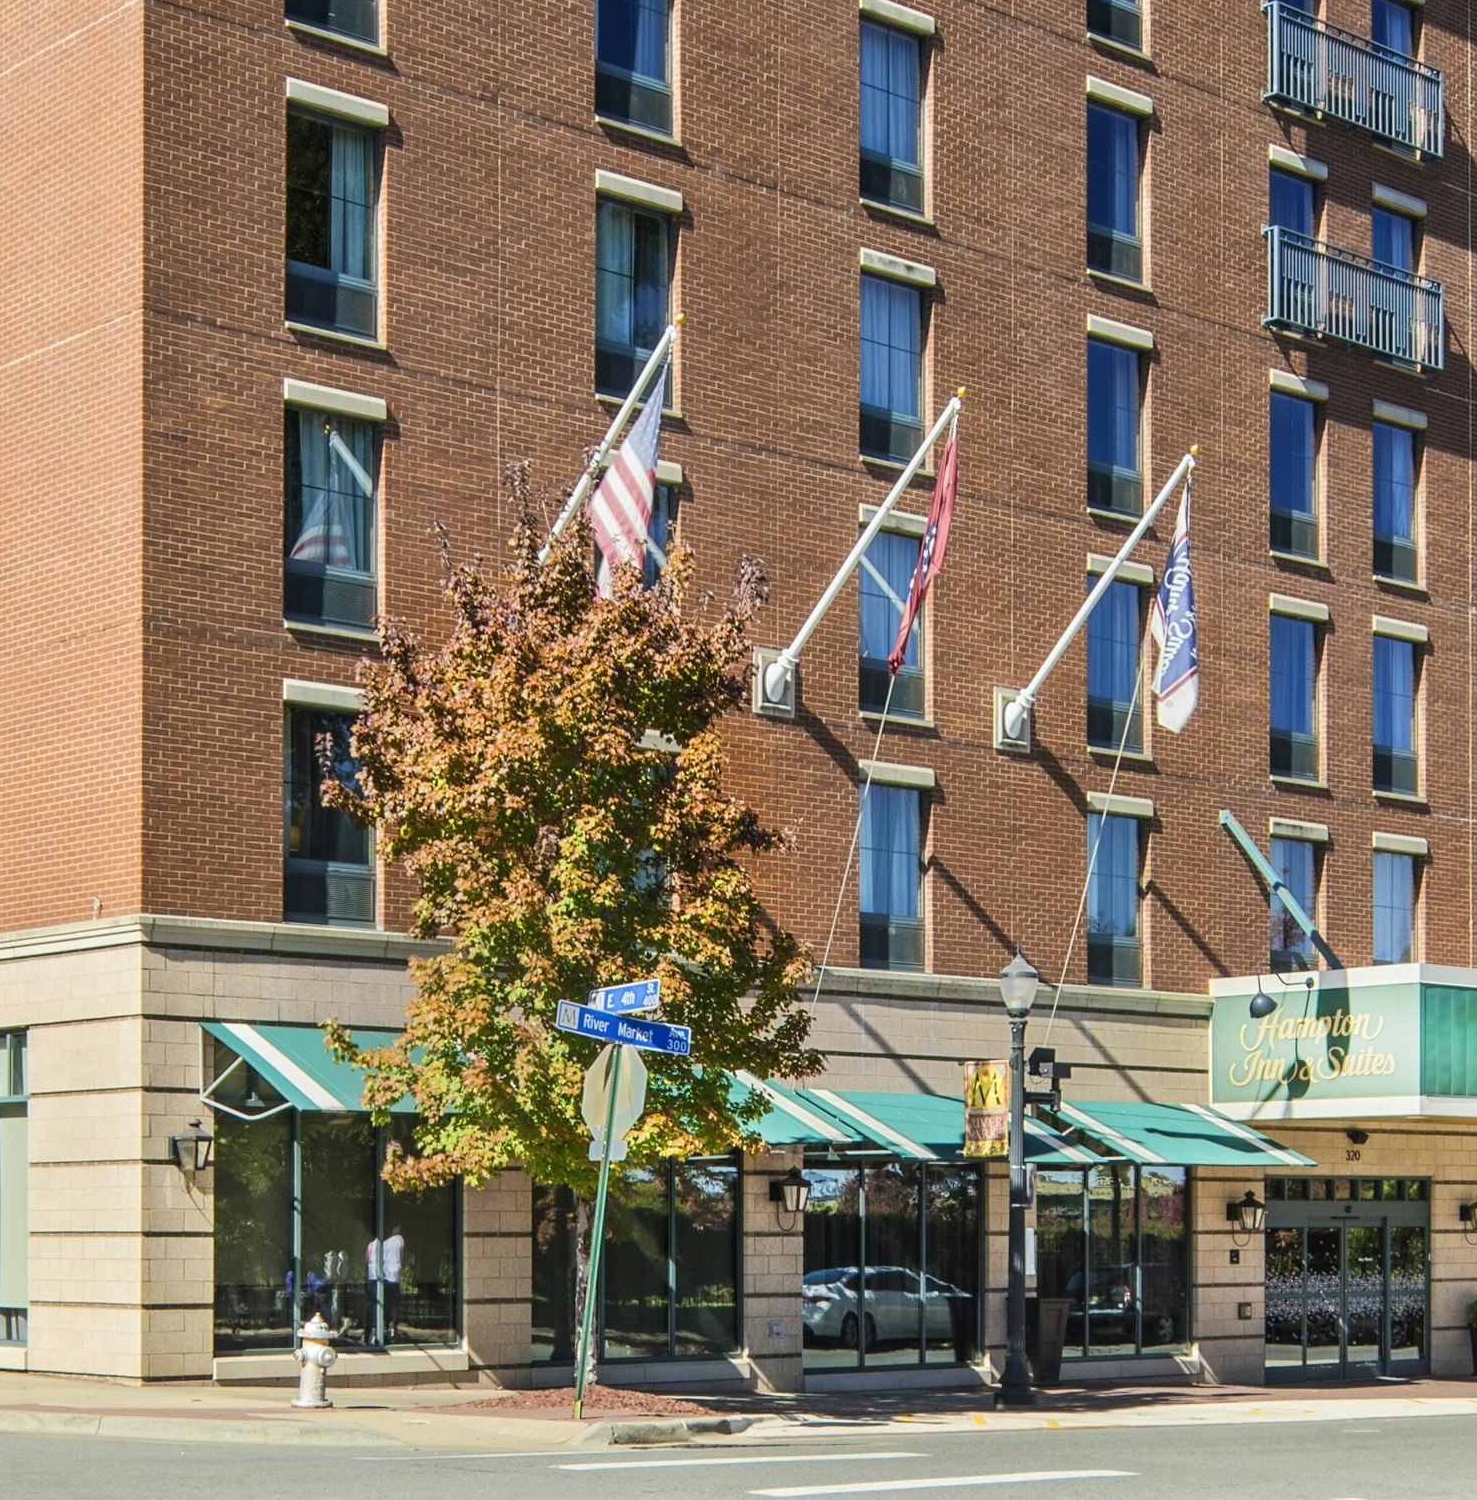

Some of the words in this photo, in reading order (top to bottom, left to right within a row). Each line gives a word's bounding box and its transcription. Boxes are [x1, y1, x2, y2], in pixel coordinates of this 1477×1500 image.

[621, 991, 635, 1005] 4th
[643, 994, 656, 1007] 400
[583, 1013, 610, 1033] River
[617, 1022, 654, 1043] Market
[1240, 1007, 1383, 1052] Hampton
[667, 1039, 687, 1052] 300
[1229, 1051, 1298, 1087] Inn
[1298, 1056, 1320, 1084] &
[1317, 1046, 1396, 1081] Suites
[971, 1117, 1003, 1129] RIVER
[1346, 1150, 1360, 1161] 320
